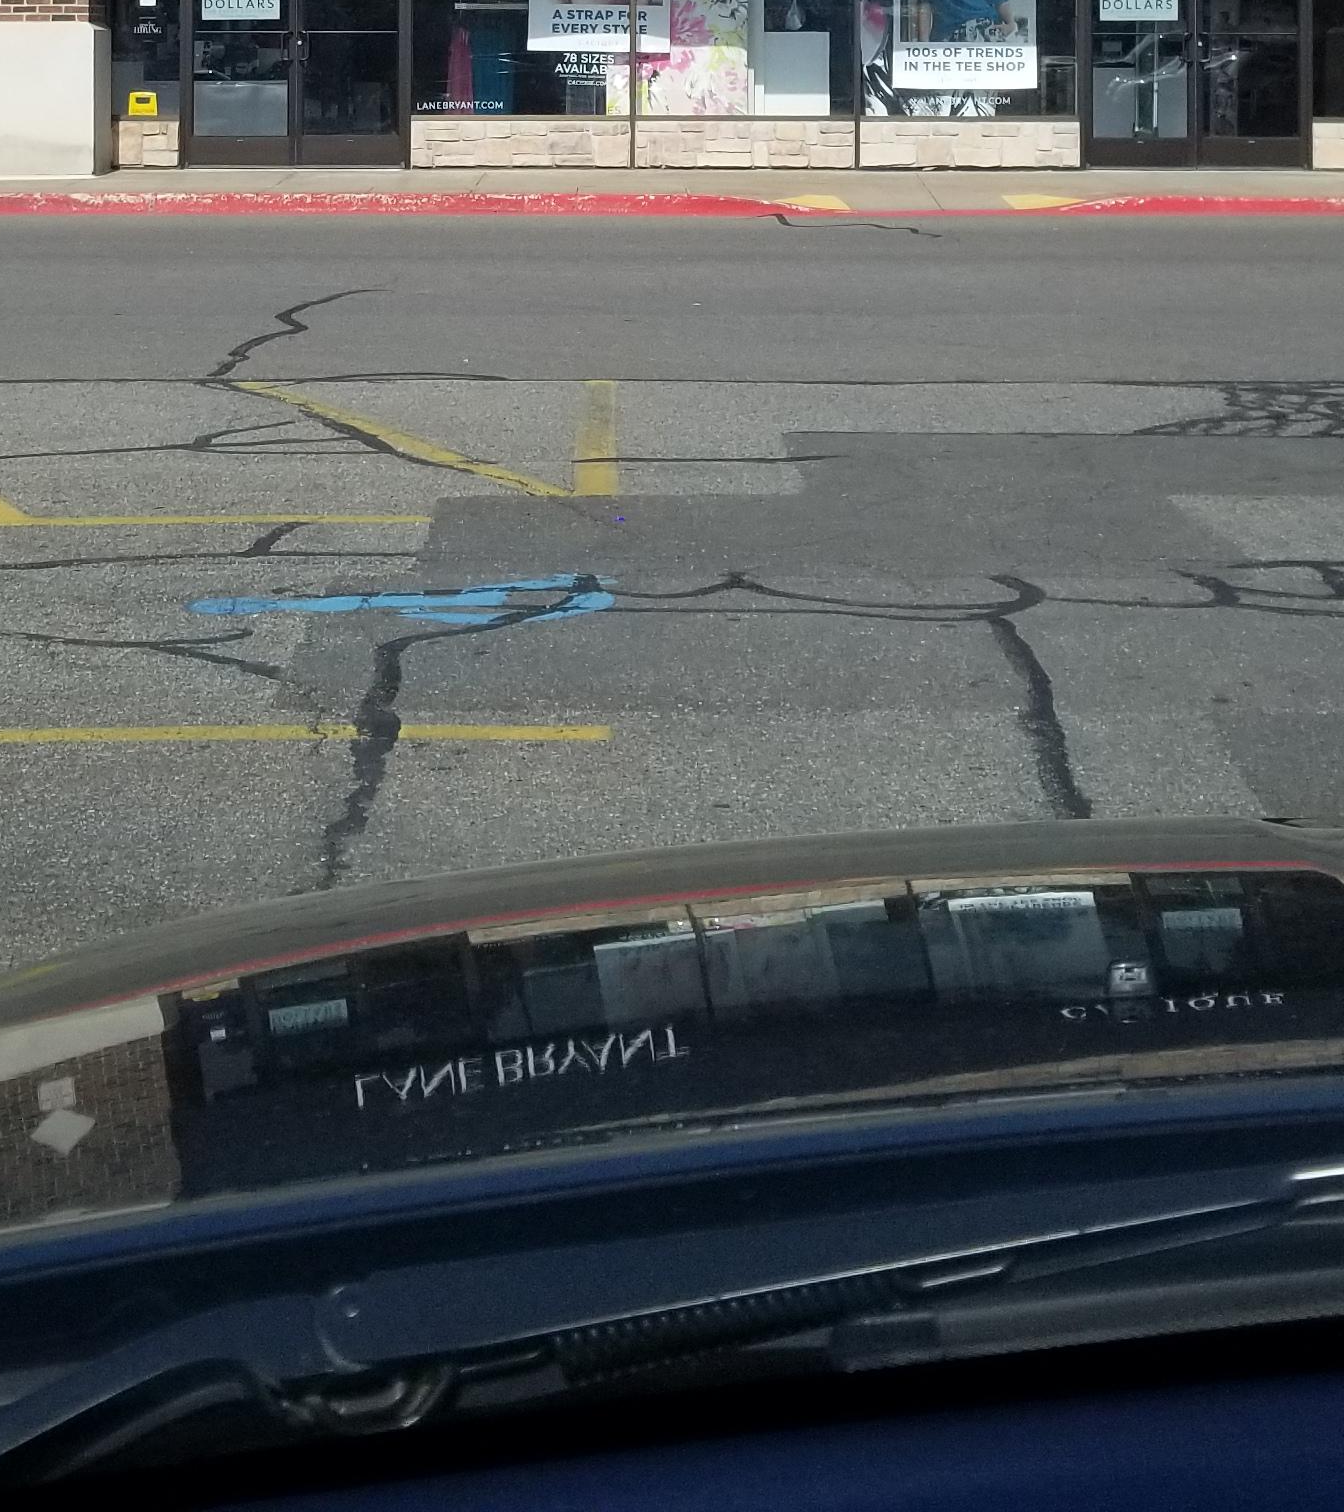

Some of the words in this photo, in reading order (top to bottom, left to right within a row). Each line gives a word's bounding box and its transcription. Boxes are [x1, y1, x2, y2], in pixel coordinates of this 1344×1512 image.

[204, 0, 274, 9] DOLLARS
[1102, 0, 1173, 10] DOLLARS
[552, 10, 563, 19] A
[567, 10, 613, 20] STRAP
[618, 11, 647, 21] FR
[552, 24, 598, 34] EVERY
[602, 24, 647, 35] STYE
[906, 47, 937, 58] 100s
[942, 47, 962, 58] OF
[967, 47, 1023, 58] TRENDS
[563, 52, 577, 63] 78
[581, 53, 615, 64] SIZES
[904, 61, 918, 71] IN
[923, 61, 951, 71] THE
[956, 61, 982, 71] TEE
[986, 61, 1025, 71] SHOP
[416, 101, 504, 110] LANEBRYANT.COM
